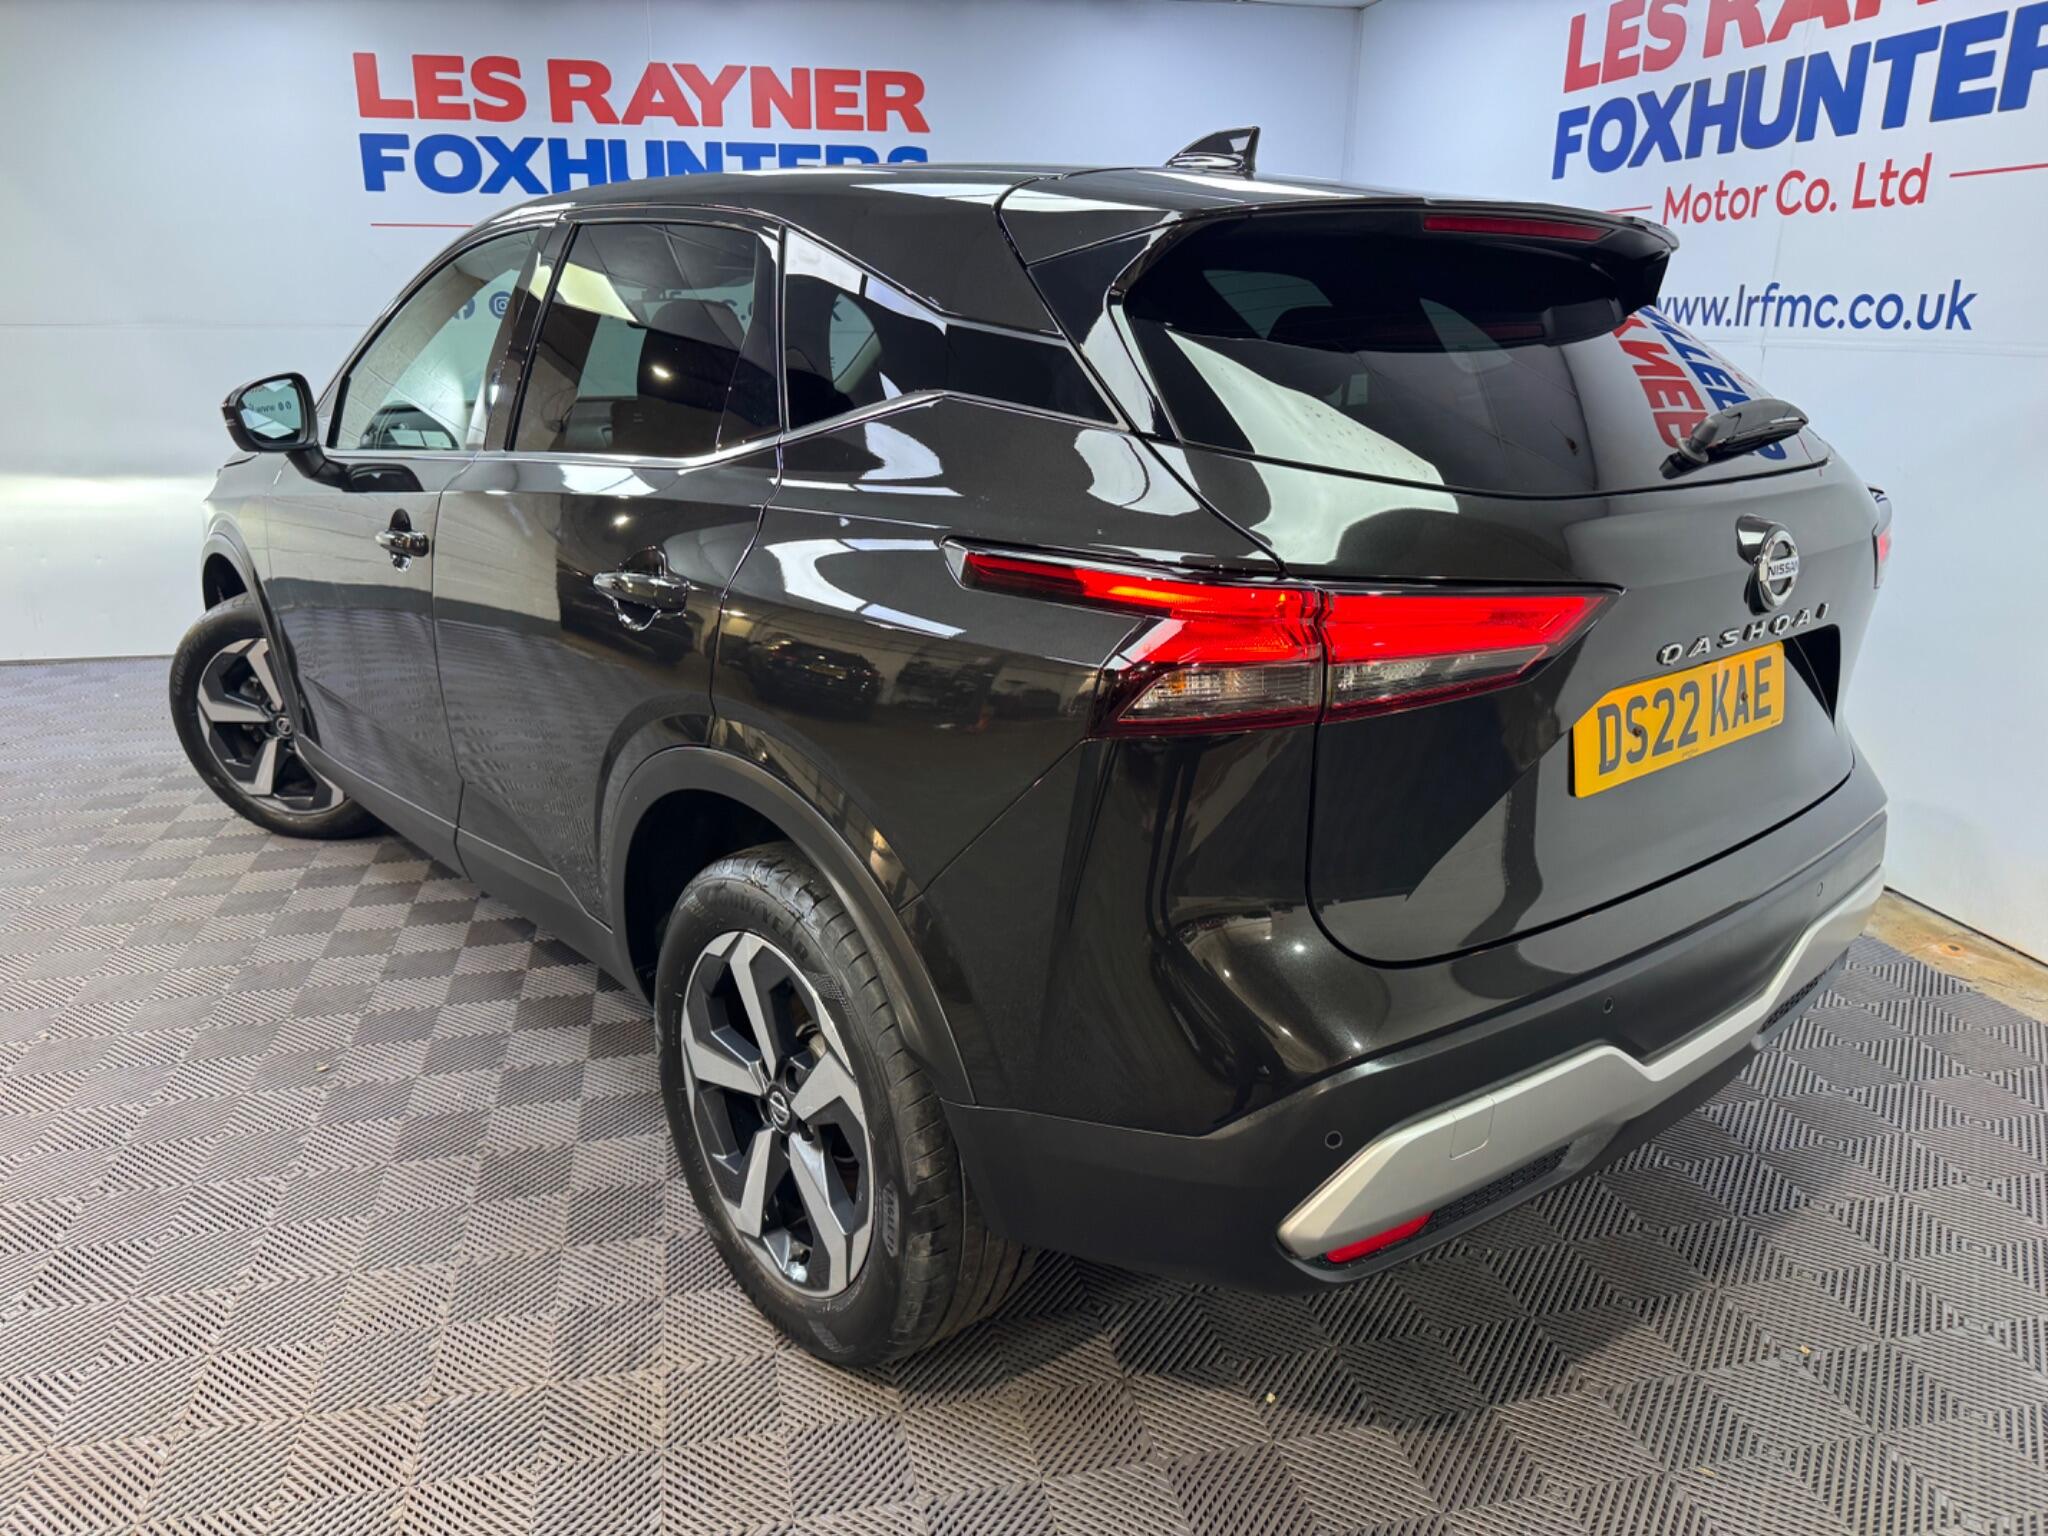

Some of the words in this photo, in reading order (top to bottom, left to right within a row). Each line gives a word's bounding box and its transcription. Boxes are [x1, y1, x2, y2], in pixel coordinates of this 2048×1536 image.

[1563, 0, 1688, 93] LES
[353, 52, 527, 123] LES
[547, 58, 931, 133] RAYNER
[358, 132, 929, 195] FOXHUN
[1662, 179, 1768, 226] Motor
[1775, 169, 1838, 216] Co.
[1852, 152, 1933, 210] Ltd
[1657, 602, 1830, 666] QASHQAI
[1596, 680, 1700, 777] DS22
[1709, 656, 1773, 738] KAE
